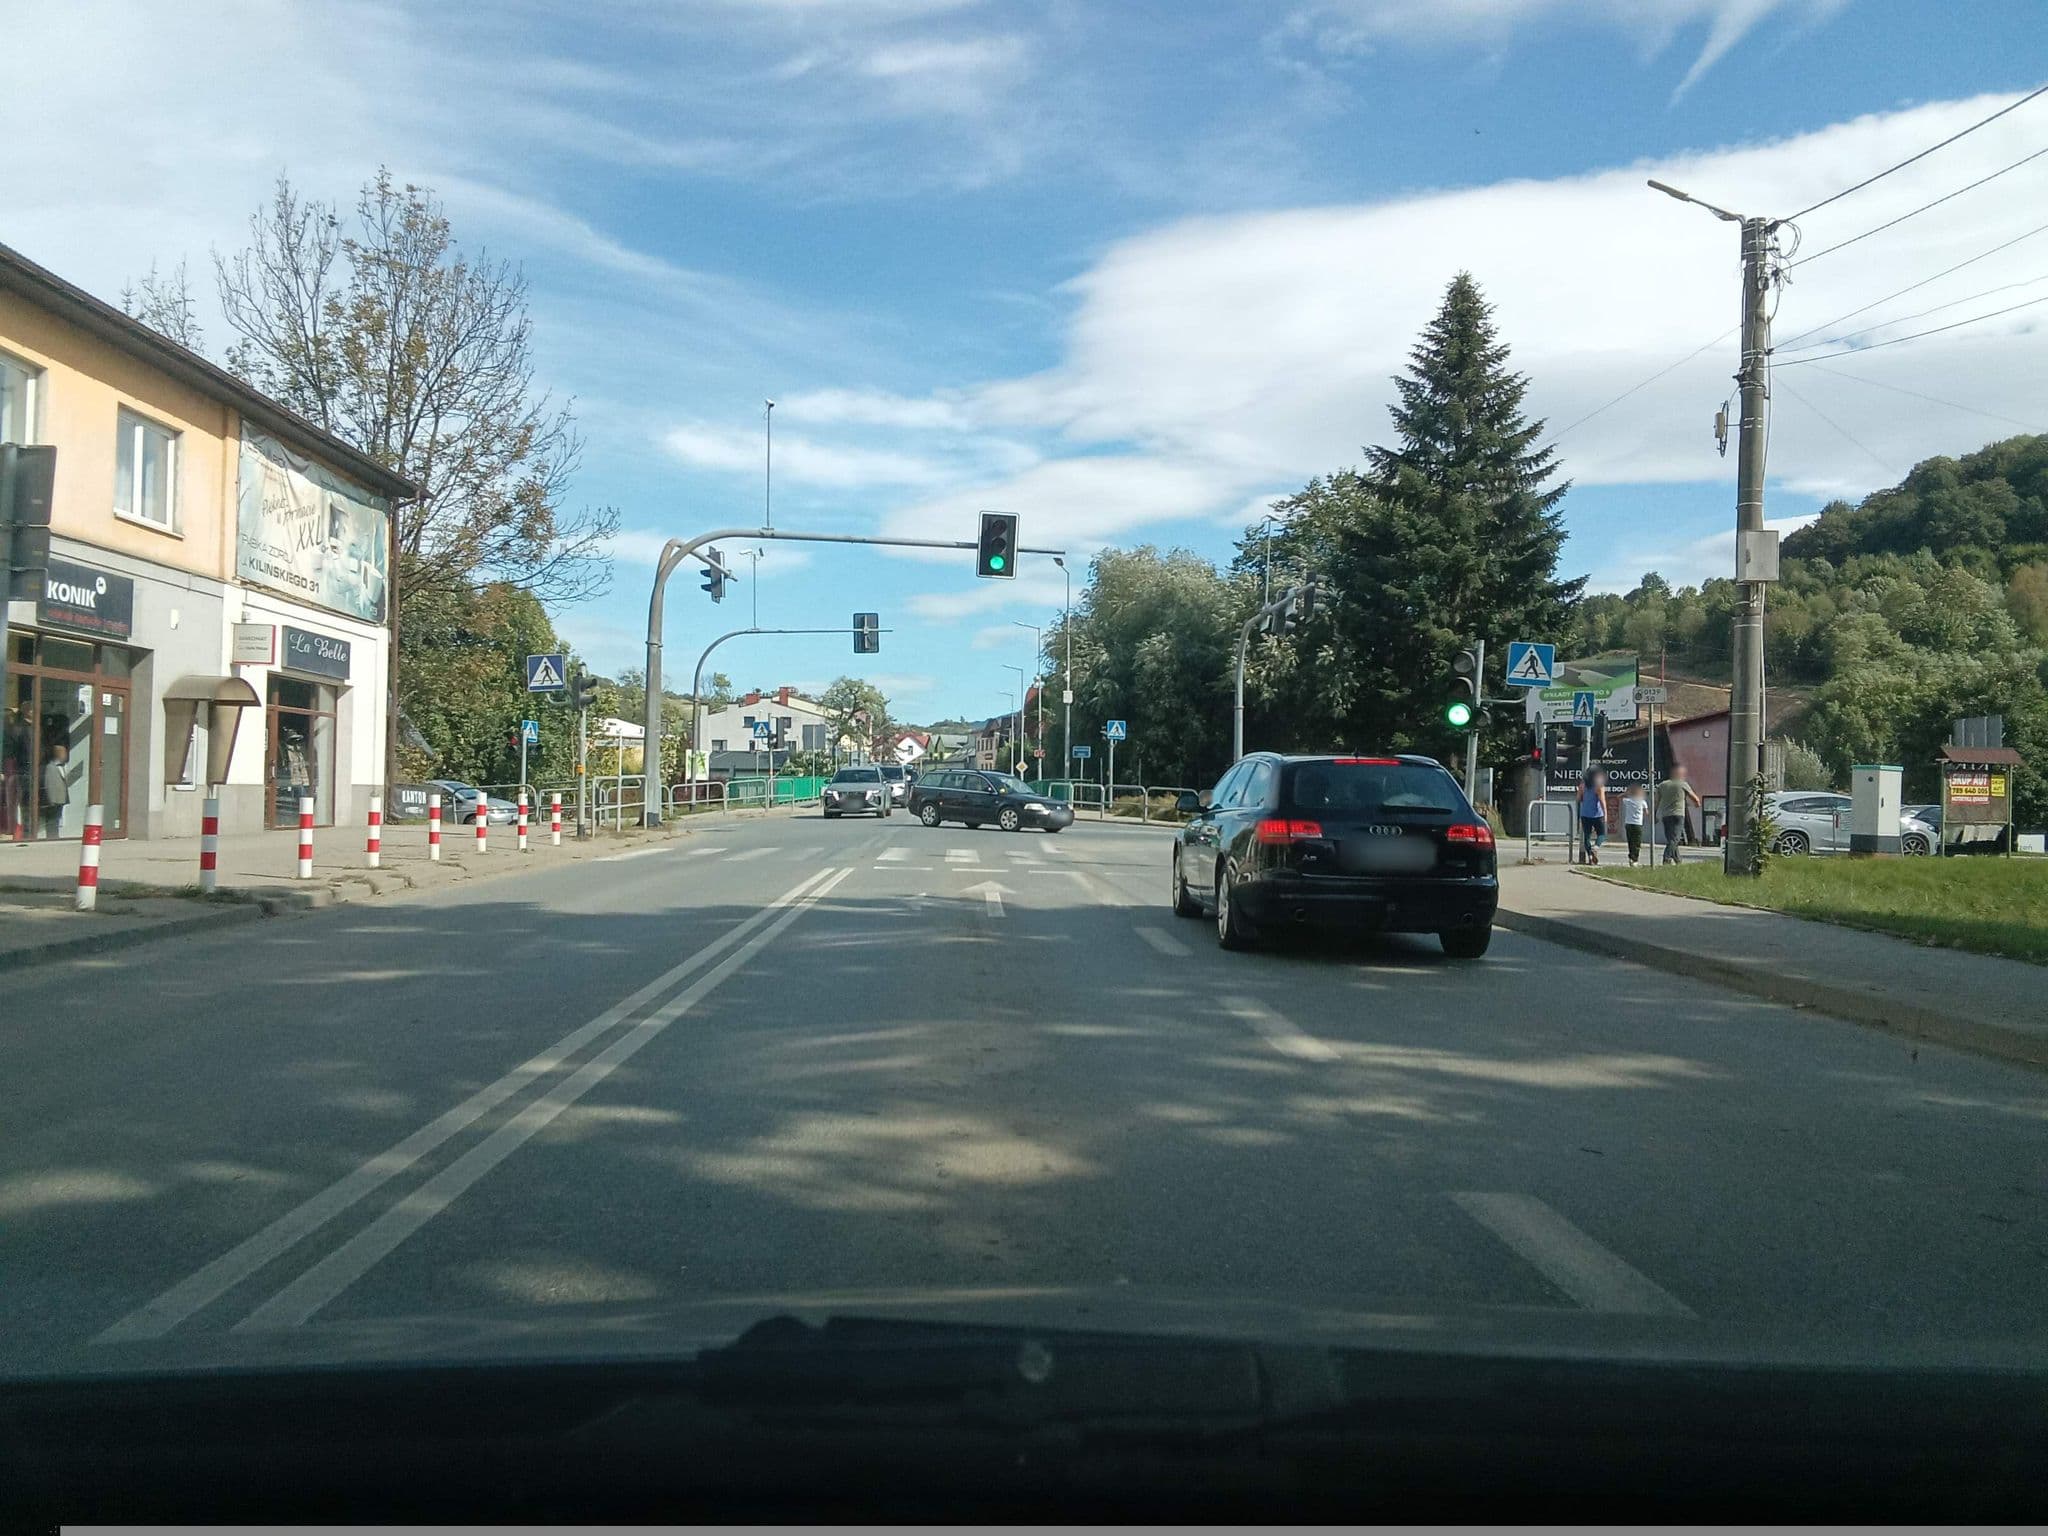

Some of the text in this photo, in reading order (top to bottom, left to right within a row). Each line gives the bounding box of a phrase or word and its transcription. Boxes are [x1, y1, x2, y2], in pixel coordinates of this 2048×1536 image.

[296, 515, 323, 553] XXL
[47, 580, 97, 608] KONIK
[309, 581, 319, 593] 31
[290, 633, 348, 662] La Belle
